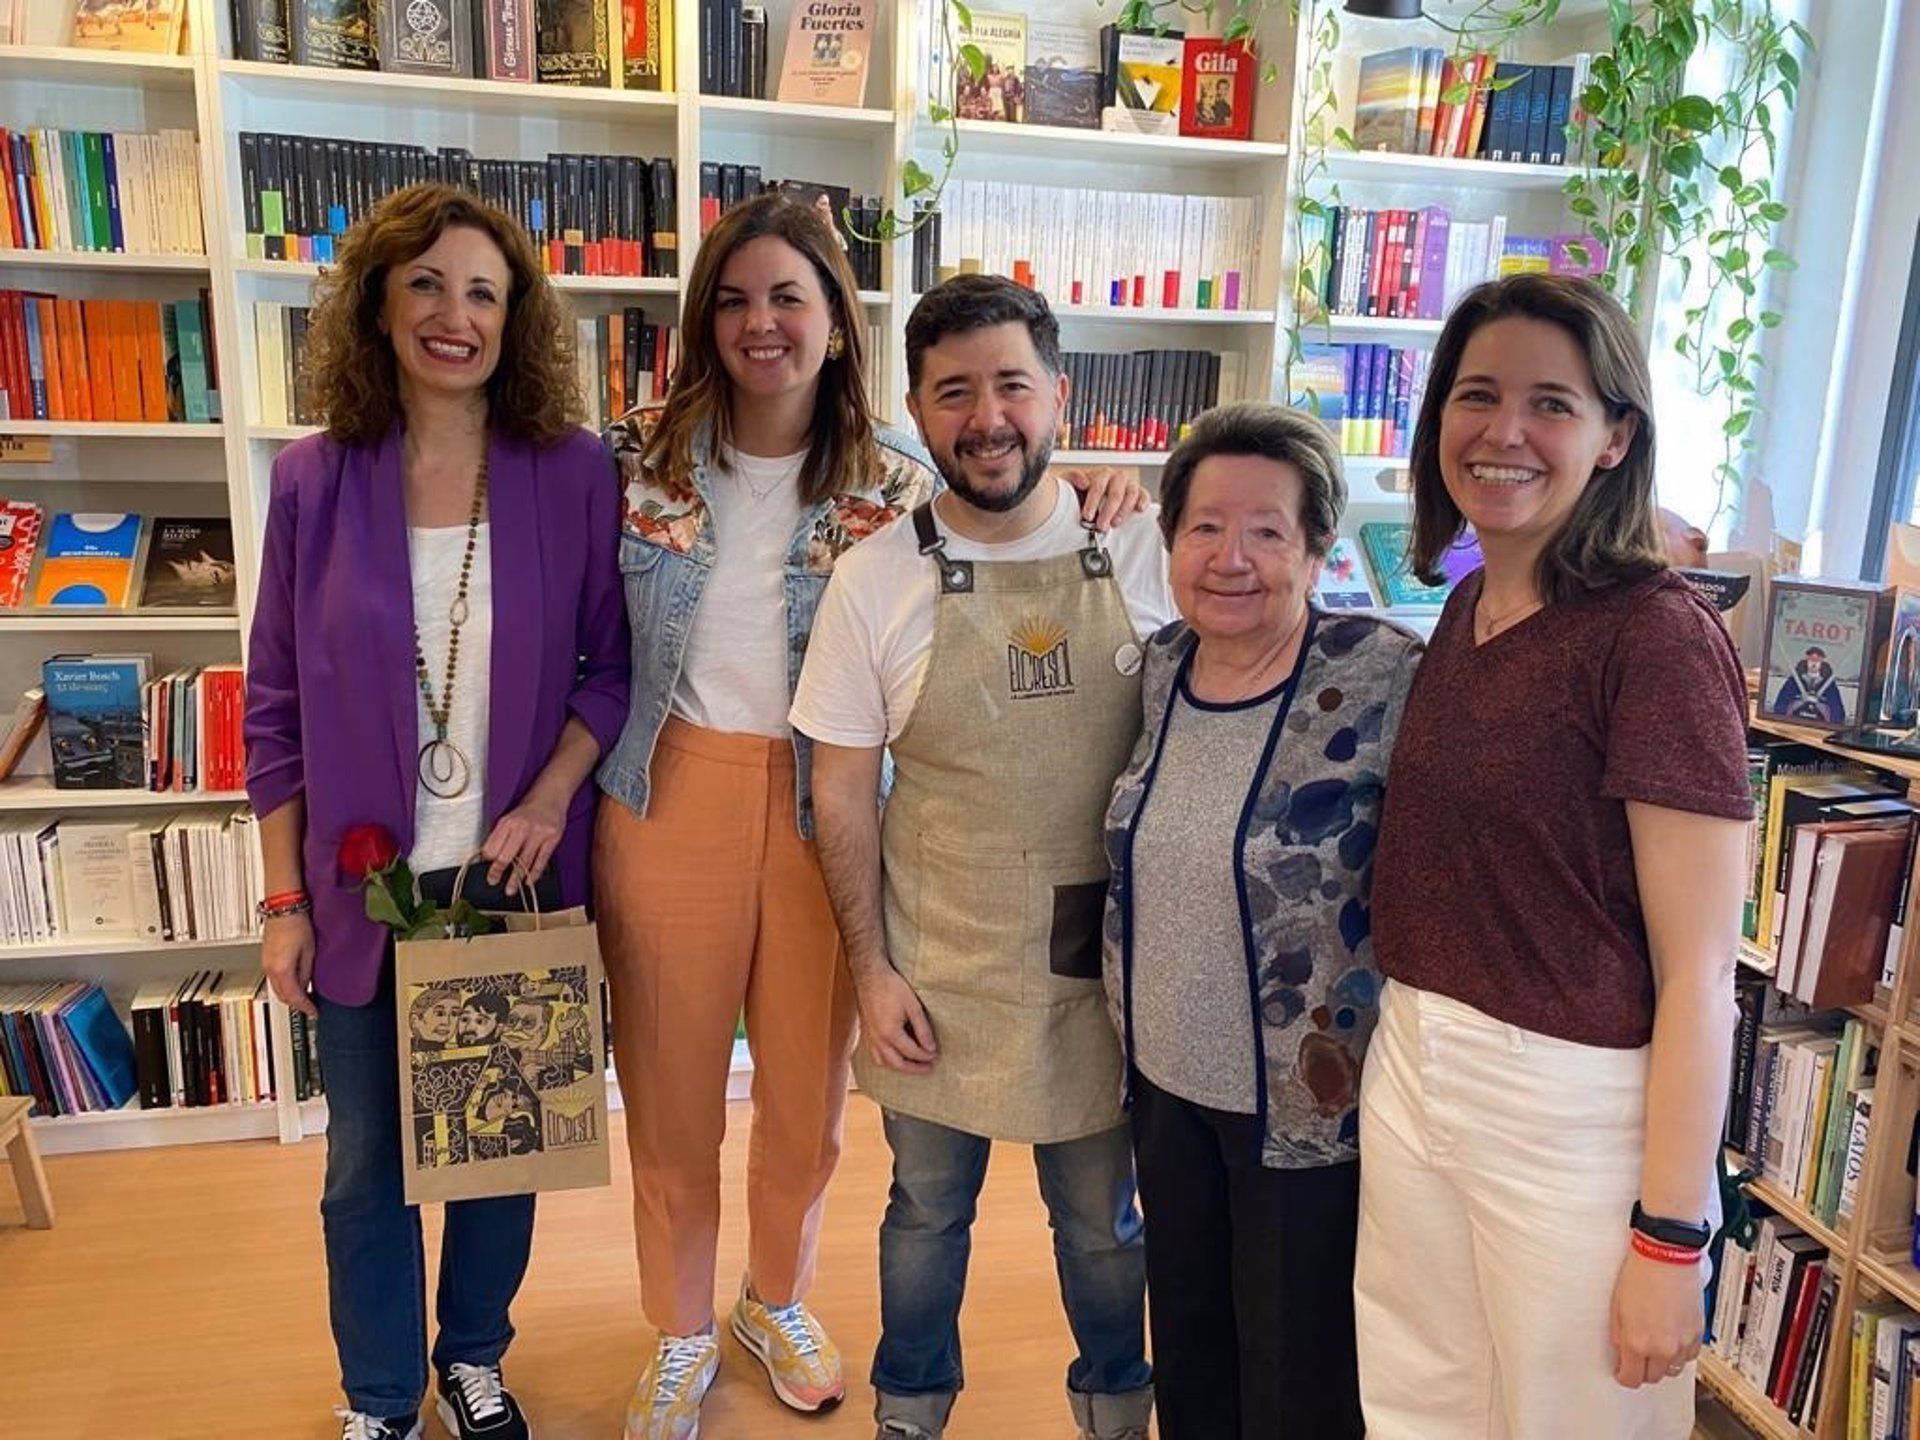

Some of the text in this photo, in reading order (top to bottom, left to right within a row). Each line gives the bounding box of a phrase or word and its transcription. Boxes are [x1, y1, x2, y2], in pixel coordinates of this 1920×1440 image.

[807, 3, 861, 16] Gloria
[800, 17, 864, 31] Fuertes
[1195, 52, 1239, 72] Gila
[1784, 618, 1857, 642] TAROT
[1776, 760, 1819, 777] Manual
